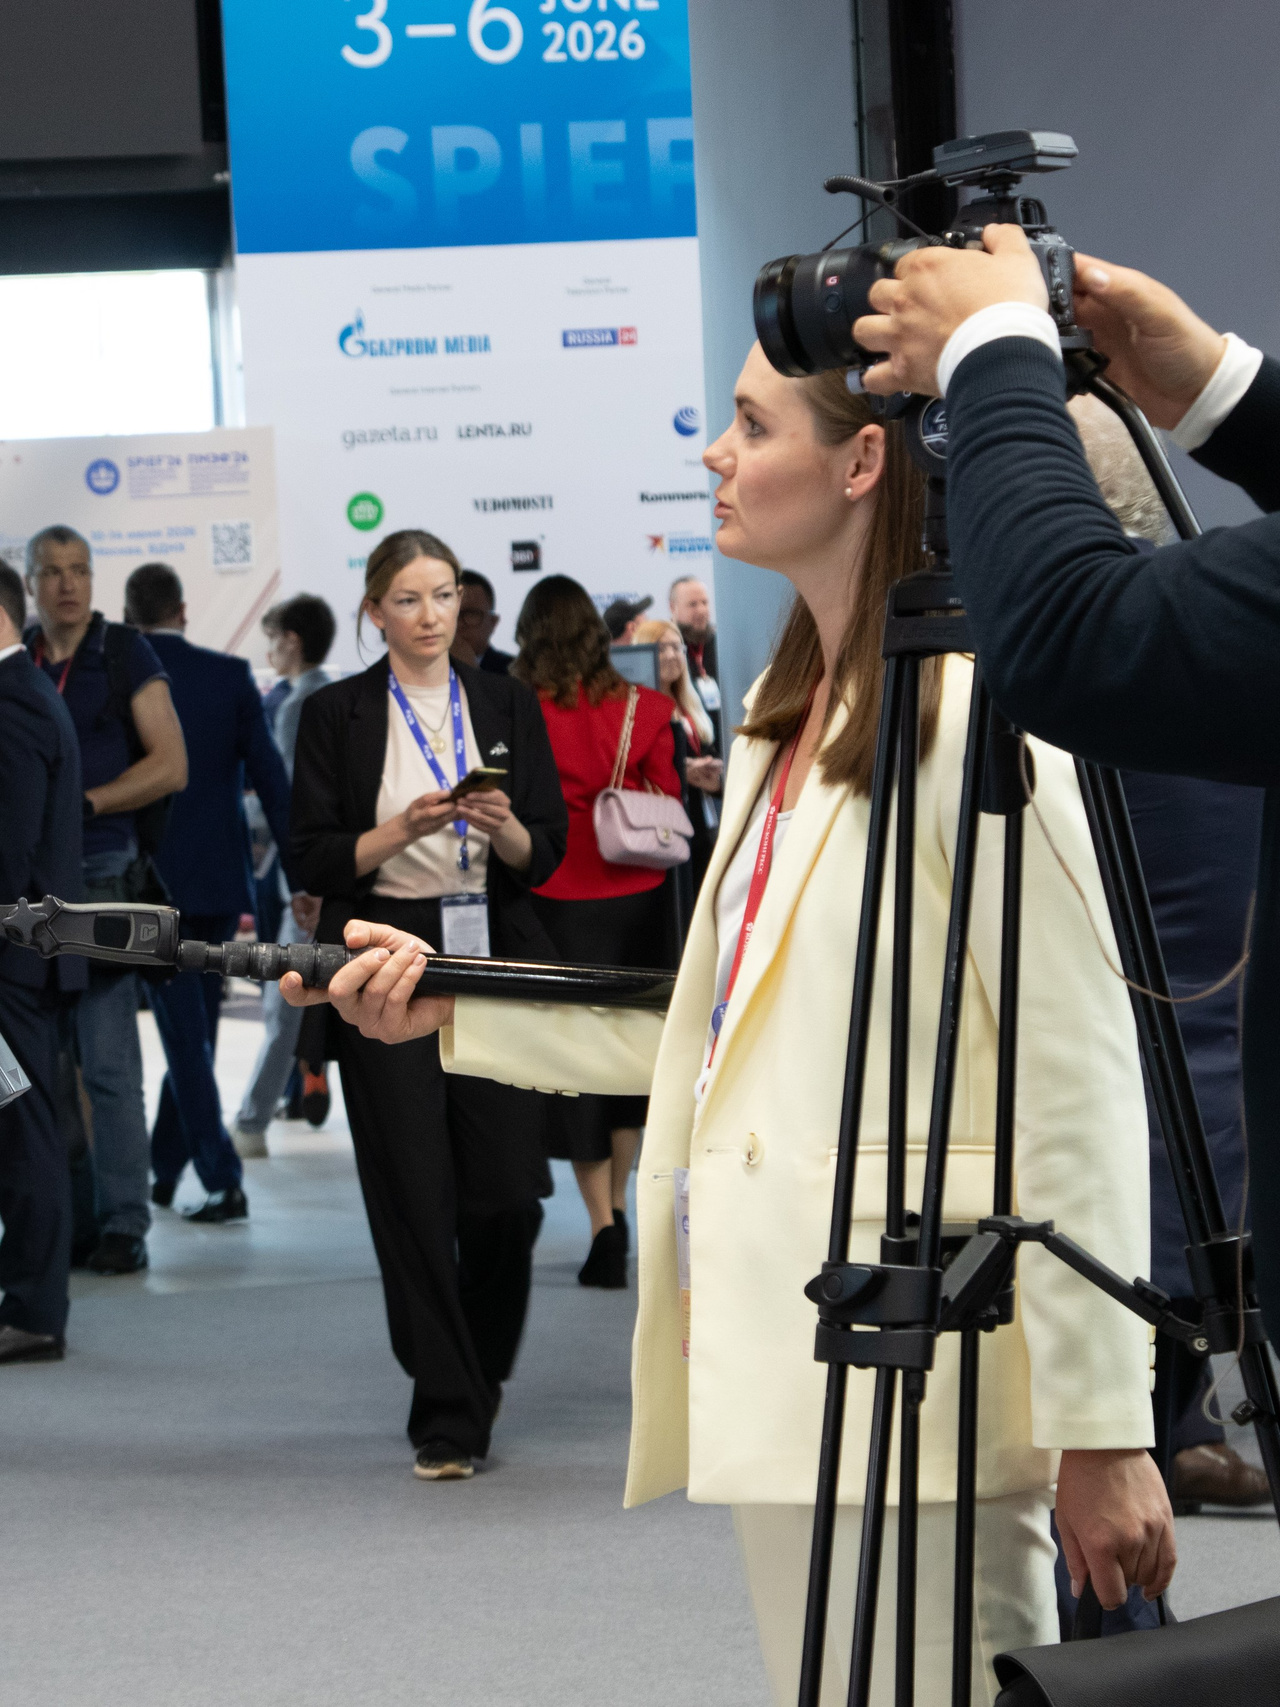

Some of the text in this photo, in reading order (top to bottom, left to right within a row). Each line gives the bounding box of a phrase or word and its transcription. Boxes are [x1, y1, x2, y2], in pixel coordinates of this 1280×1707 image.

[541, 19, 646, 63] 2026
[444, 334, 492, 355] MEDIA
[567, 331, 614, 345] RUSSIA
[342, 424, 438, 450] gazeta.ru
[458, 422, 532, 440] LENTA.RU
[474, 494, 553, 511] VEDOMOSTI
